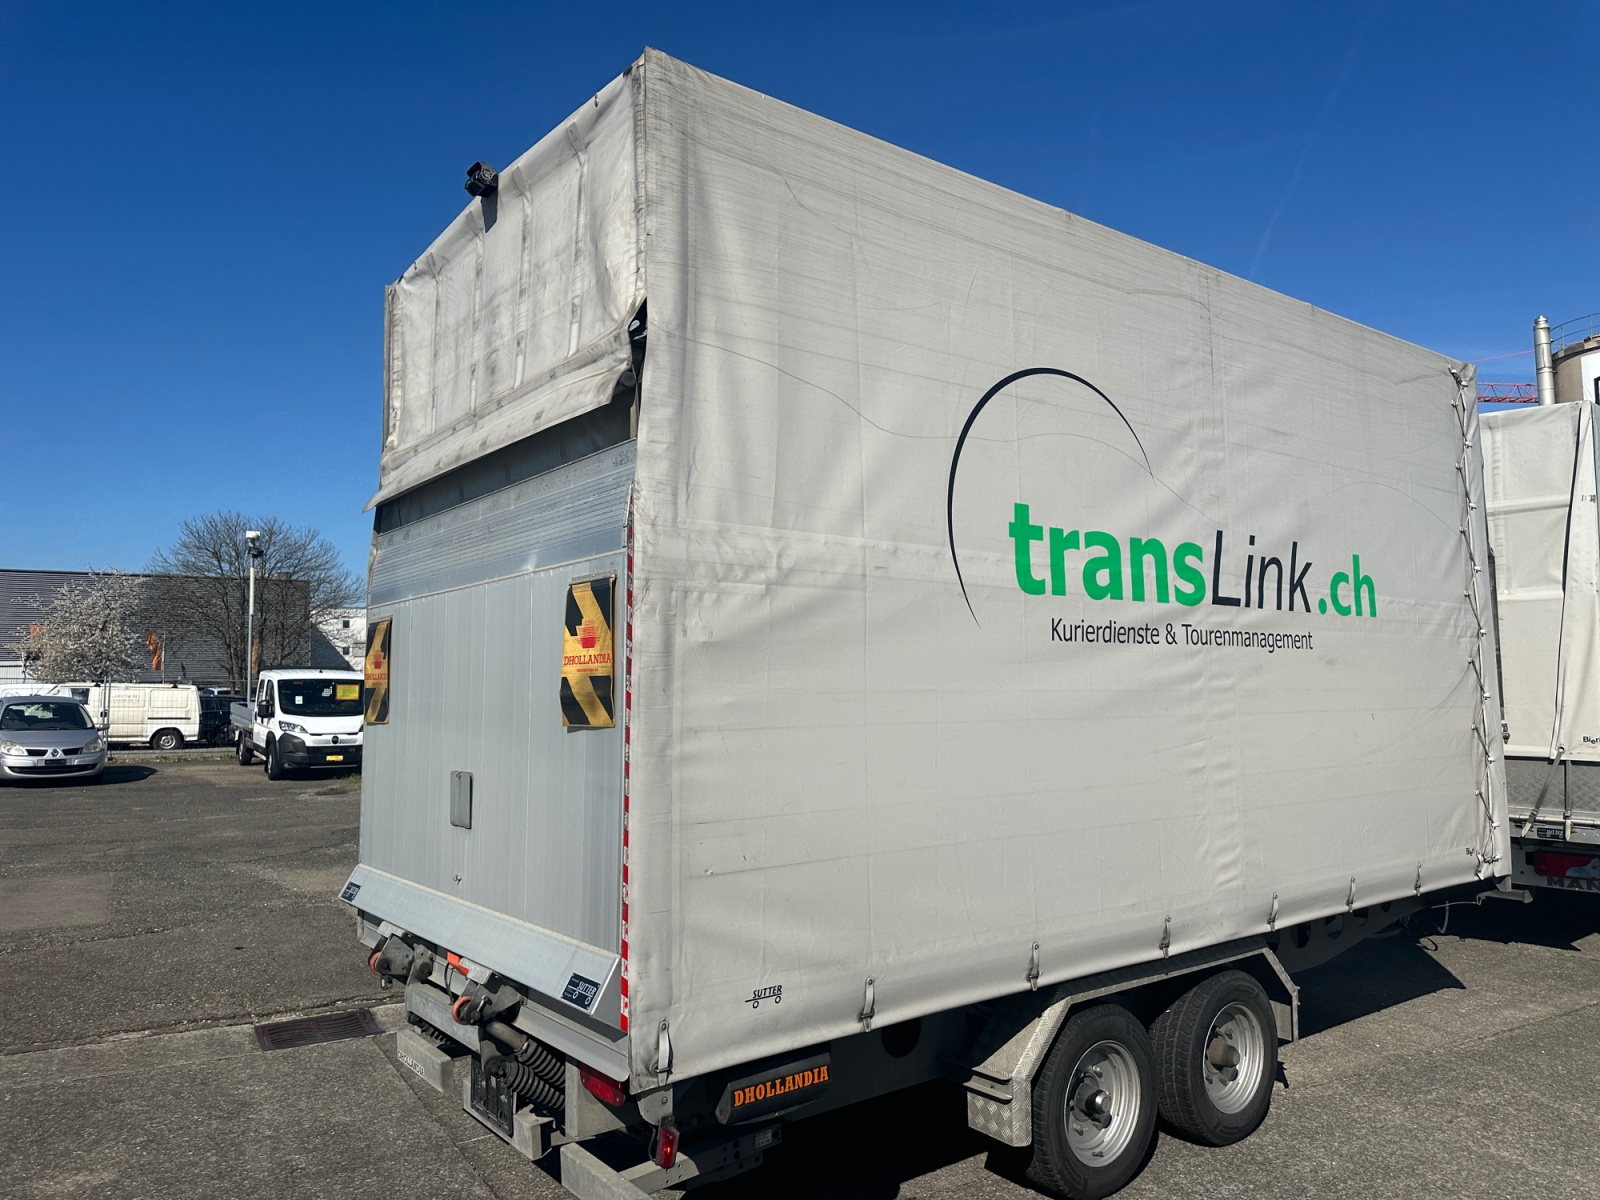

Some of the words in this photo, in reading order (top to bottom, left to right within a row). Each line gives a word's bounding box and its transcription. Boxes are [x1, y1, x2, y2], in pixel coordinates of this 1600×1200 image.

[1008, 502, 1378, 618] transLink.ch
[1051, 617, 1160, 645] Kurierdienste
[1165, 623, 1178, 645] &
[1181, 624, 1314, 653] Tourenmanagement
[563, 653, 612, 666] DHOLLANDIA
[577, 981, 597, 997] SUTTER
[752, 984, 783, 999] SUTTER
[733, 1065, 829, 1107] DHOLLANDIA
